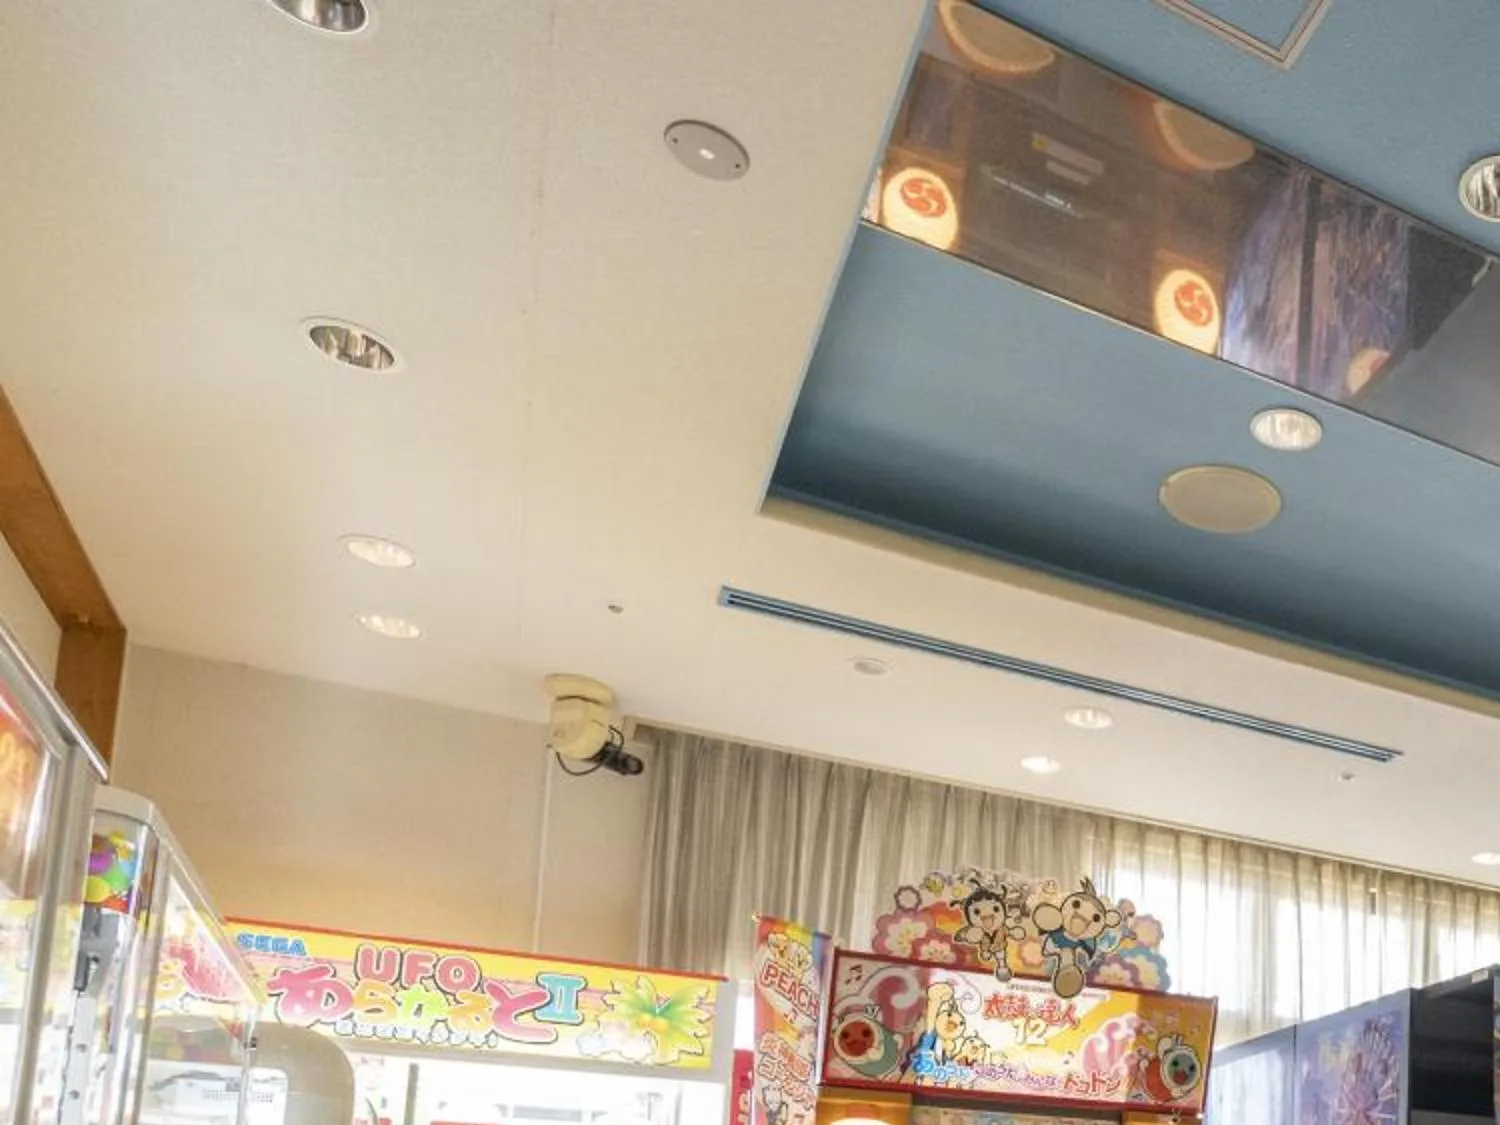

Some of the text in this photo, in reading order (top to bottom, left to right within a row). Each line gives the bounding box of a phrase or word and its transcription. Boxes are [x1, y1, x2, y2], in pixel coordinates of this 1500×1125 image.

[236, 932, 308, 957] SEGA
[355, 944, 483, 994] UFO
[761, 962, 820, 1021] PEACH
[1013, 1019, 1049, 1047] 12
